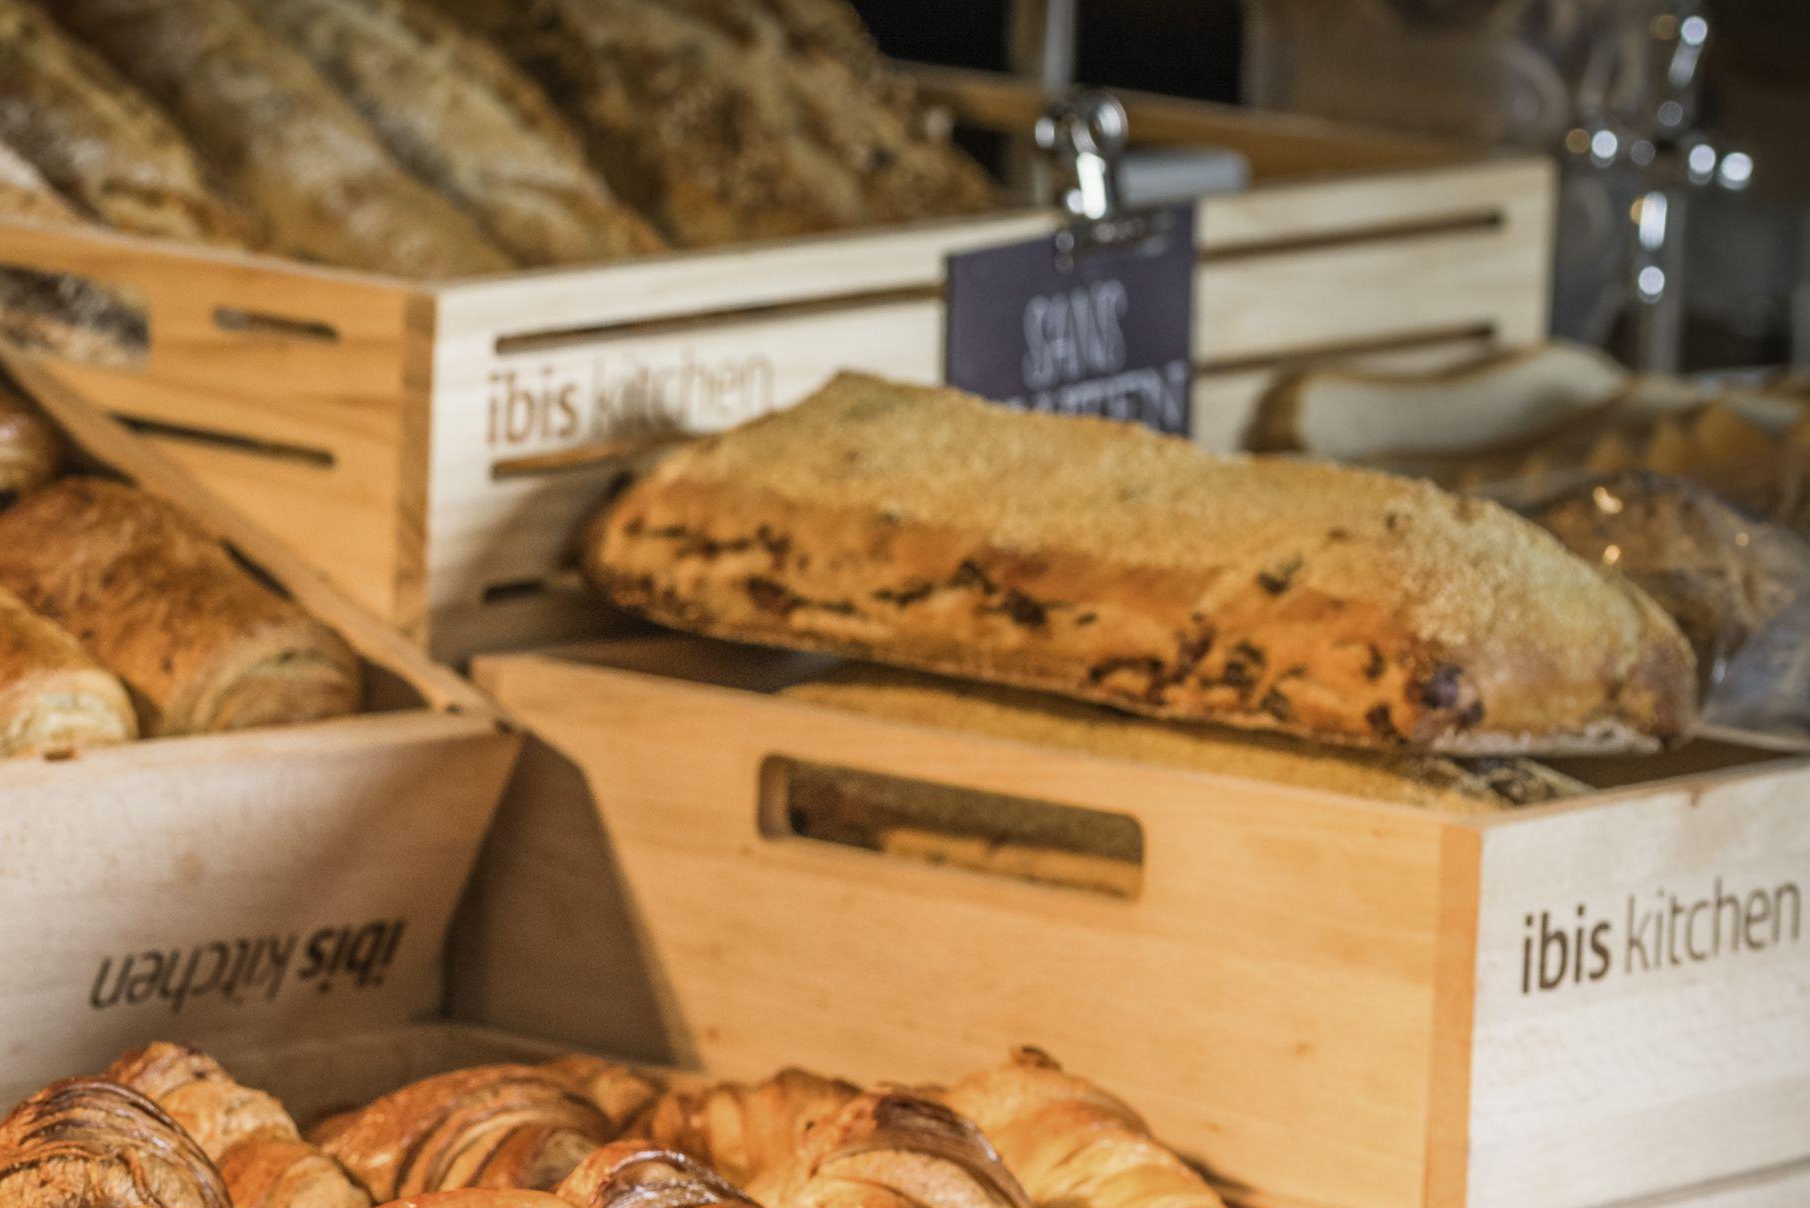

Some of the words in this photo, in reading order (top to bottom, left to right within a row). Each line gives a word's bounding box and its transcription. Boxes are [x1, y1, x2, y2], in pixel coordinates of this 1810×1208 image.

[486, 365, 580, 447] ibis
[88, 931, 296, 1014] kitchen
[297, 917, 408, 995] ibis
[1521, 902, 1612, 995] ibis
[1624, 876, 1802, 975] kitchen
